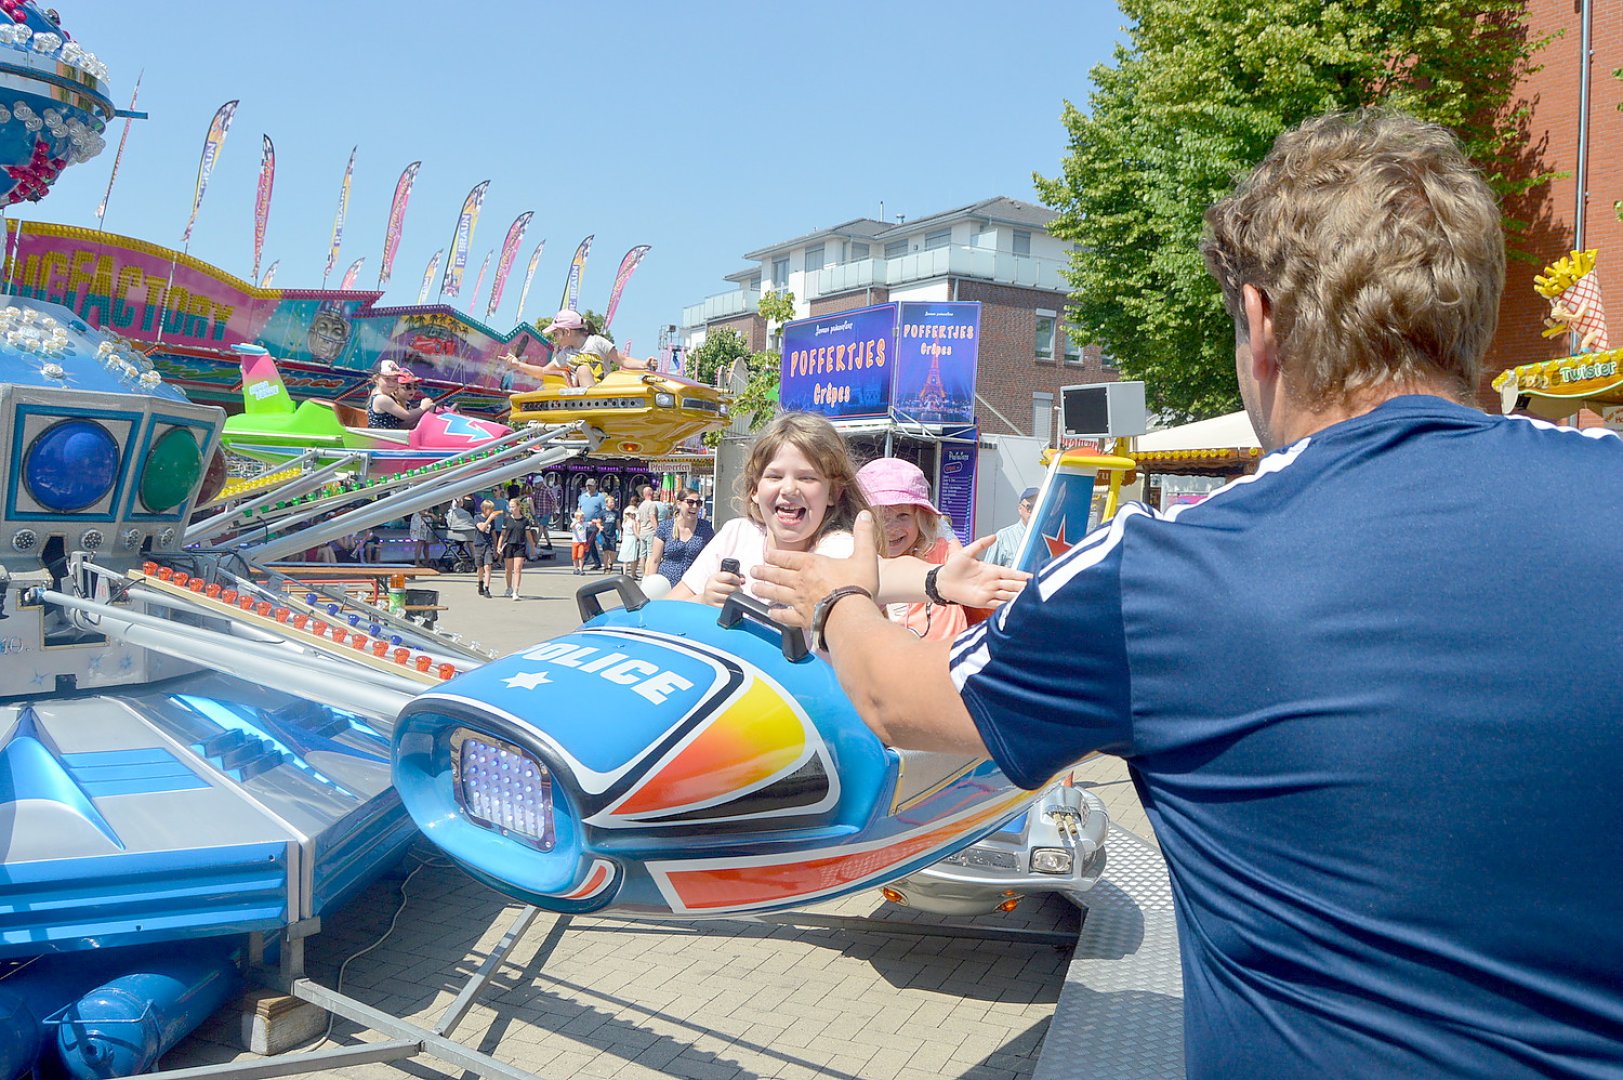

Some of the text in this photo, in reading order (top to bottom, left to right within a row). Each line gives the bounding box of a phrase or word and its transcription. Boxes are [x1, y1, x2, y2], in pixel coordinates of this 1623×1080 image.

[458, 213, 471, 252] BRAUN
[62, 250, 234, 341] FACTORY
[903, 324, 974, 340] POFFERTJES
[791, 338, 886, 378] POFFERTJES
[921, 342, 952, 357] Crêpes
[1559, 361, 1617, 382] Twister
[814, 382, 850, 408] Crêpes
